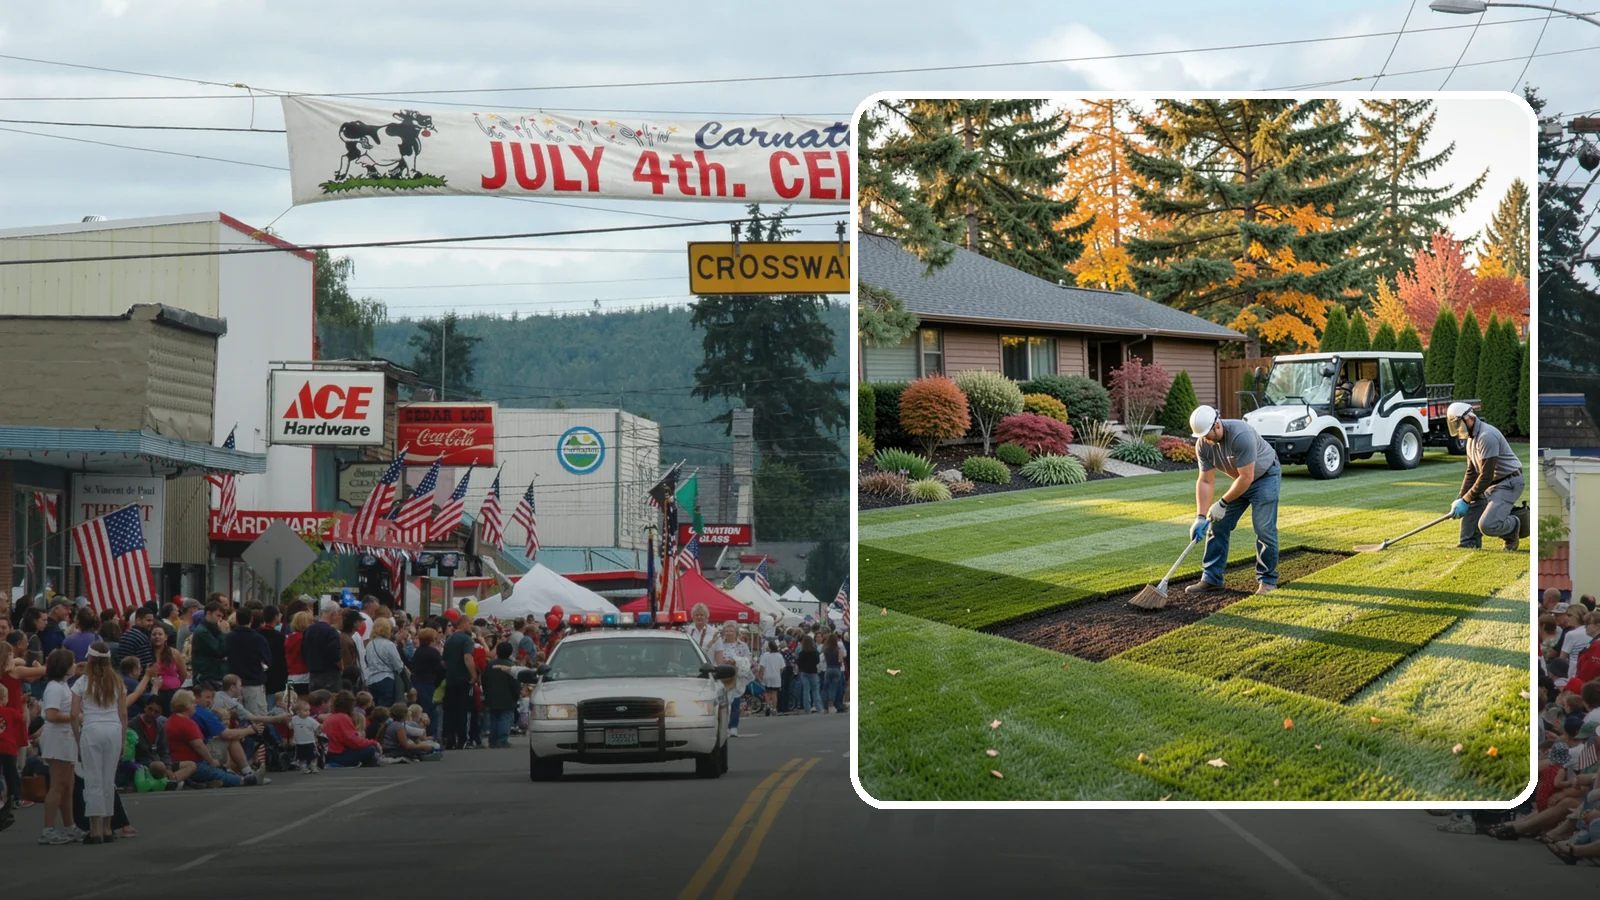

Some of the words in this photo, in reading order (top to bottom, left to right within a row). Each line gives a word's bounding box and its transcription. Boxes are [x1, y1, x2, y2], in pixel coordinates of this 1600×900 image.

[481, 141, 605, 192] JULY
[632, 150, 746, 197] 4th.
[697, 254, 850, 280] CROSSWA
[283, 380, 373, 420] ACE
[405, 409, 452, 422] CEDAR
[284, 421, 371, 436] Hardware
[416, 428, 477, 447] Coca-Cola
[354, 467, 385, 477] Simpl
[83, 485, 93, 494] St.
[96, 485, 124, 494] Vincent
[126, 486, 136, 495] de
[138, 486, 155, 495] Paul
[212, 515, 331, 535] HARDARE
[688, 526, 741, 535] CRNATION
[699, 535, 730, 543] GLASS
